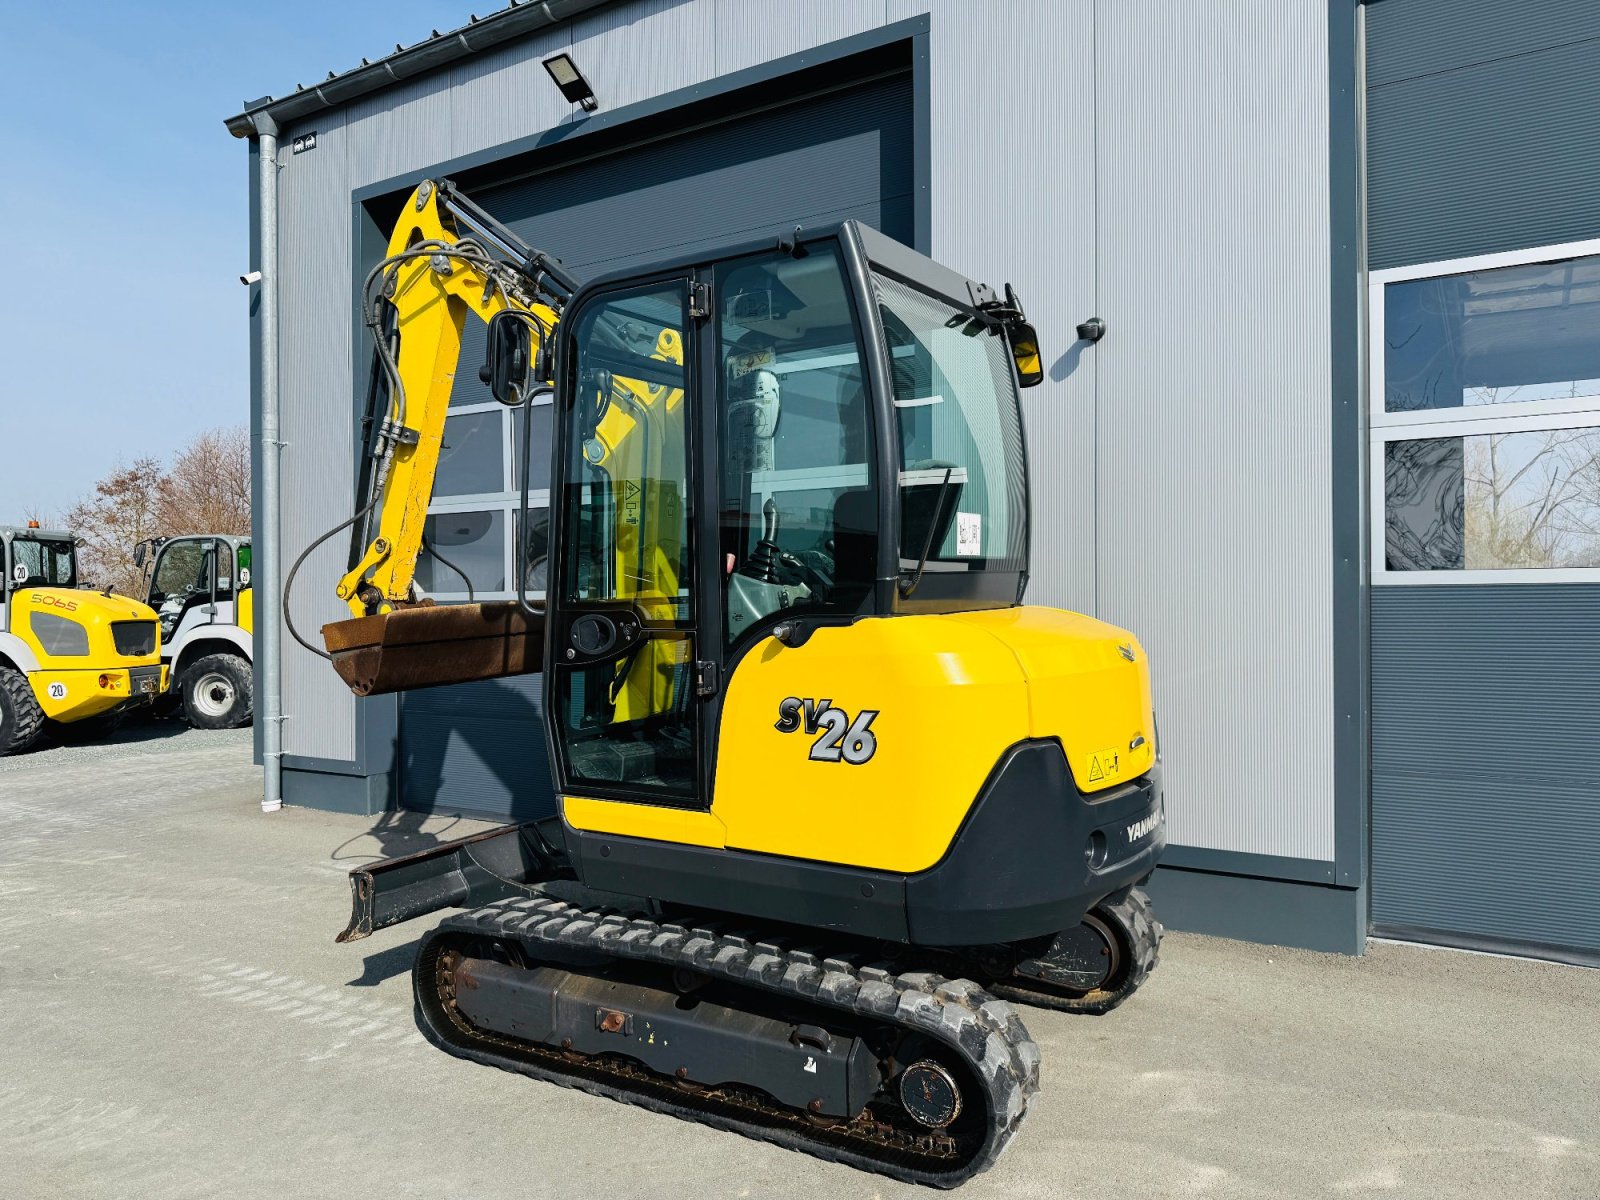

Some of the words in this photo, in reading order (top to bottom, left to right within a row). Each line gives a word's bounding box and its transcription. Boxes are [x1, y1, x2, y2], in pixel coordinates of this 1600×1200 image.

[17, 567, 26, 579] 20
[31, 593, 79, 612] 5065
[51, 684, 64, 697] 20
